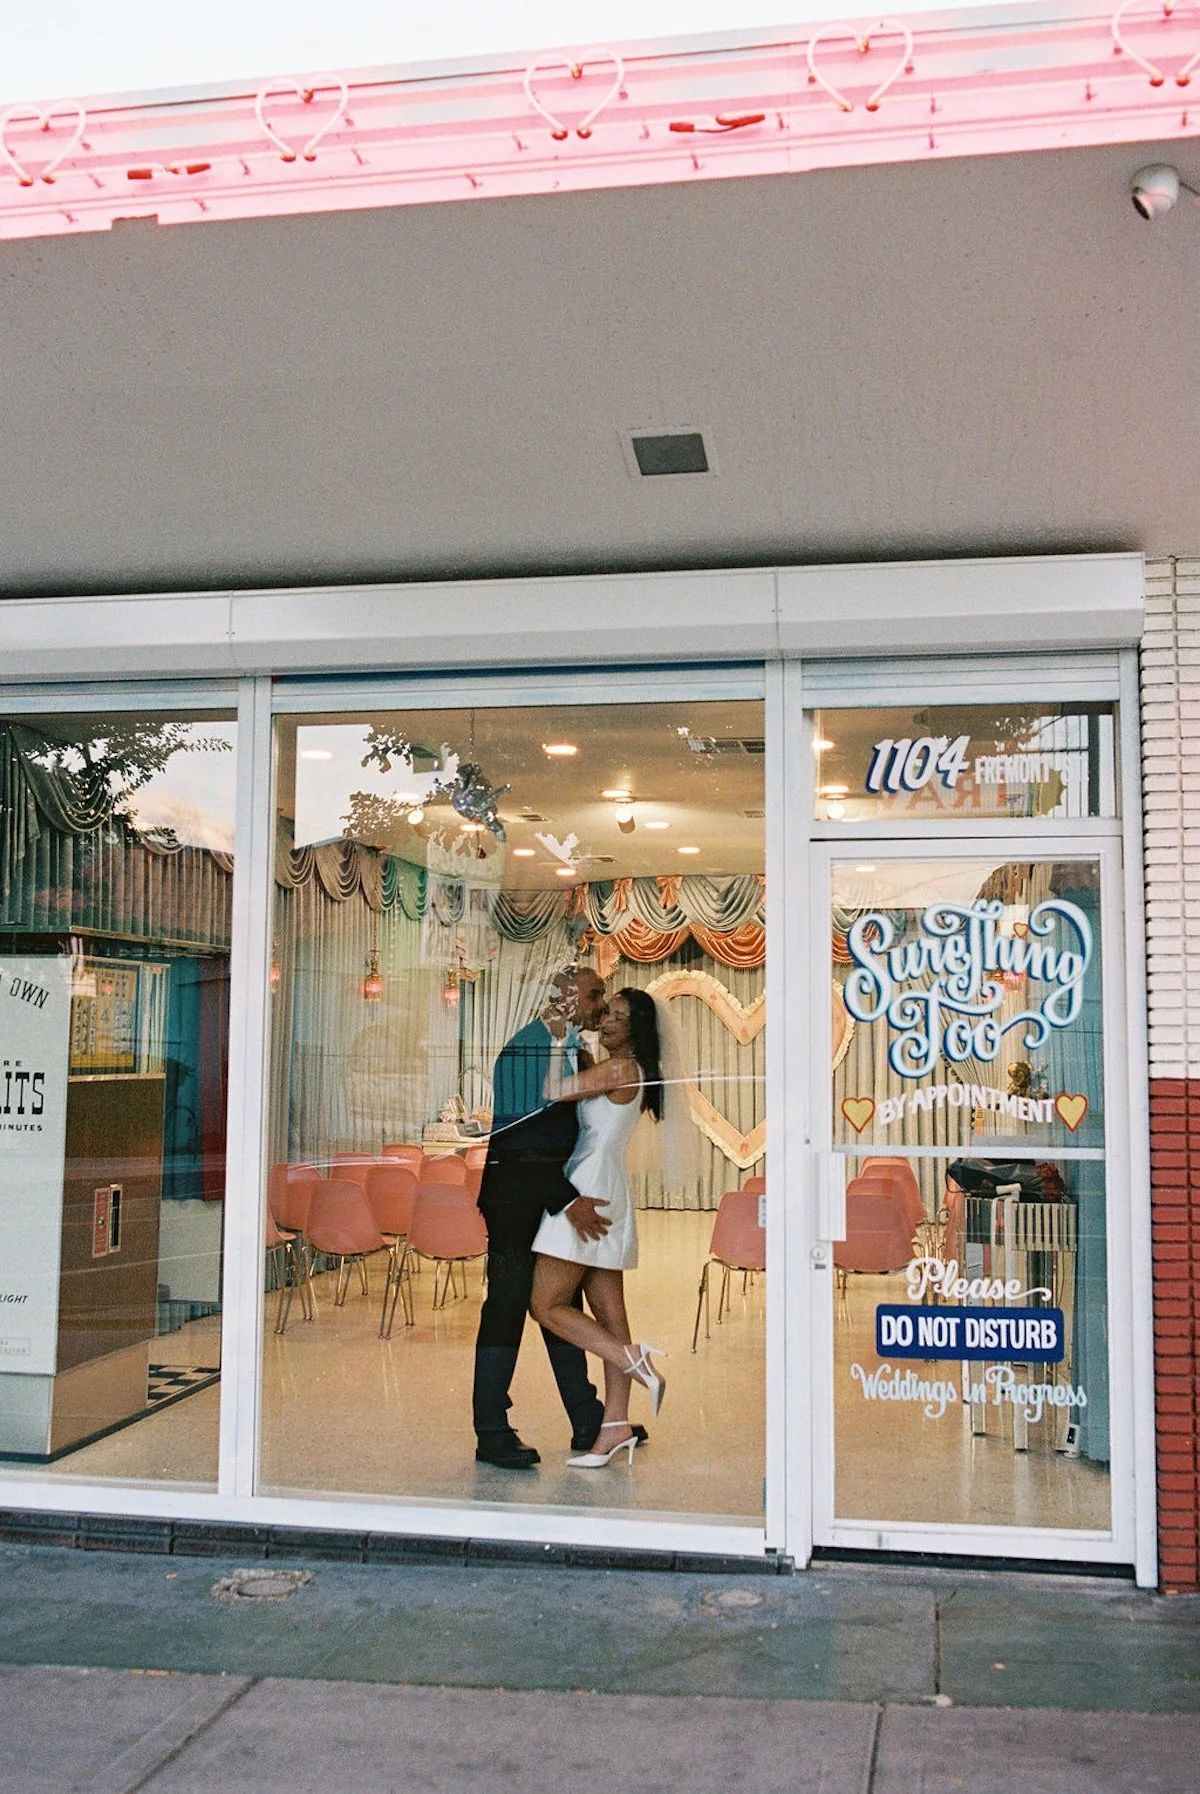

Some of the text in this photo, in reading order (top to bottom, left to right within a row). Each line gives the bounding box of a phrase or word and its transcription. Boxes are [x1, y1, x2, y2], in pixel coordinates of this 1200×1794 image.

[866, 735, 970, 793] 1104
[975, 754, 1049, 783] FREMONT
[844, 899, 1093, 1029] Sure Thing
[9, 977, 50, 1009] OWN
[886, 980, 1051, 1078] Too
[0, 1071, 45, 1115] ITS
[877, 1082, 1056, 1126] BY APPOINTMENT
[0, 1123, 43, 1132] INUTES
[906, 1256, 1052, 1302] Please
[880, 1314, 1058, 1349] DO NOT DISTURB
[851, 1362, 958, 1419] Weddings
[985, 1364, 1088, 1423] Progress
